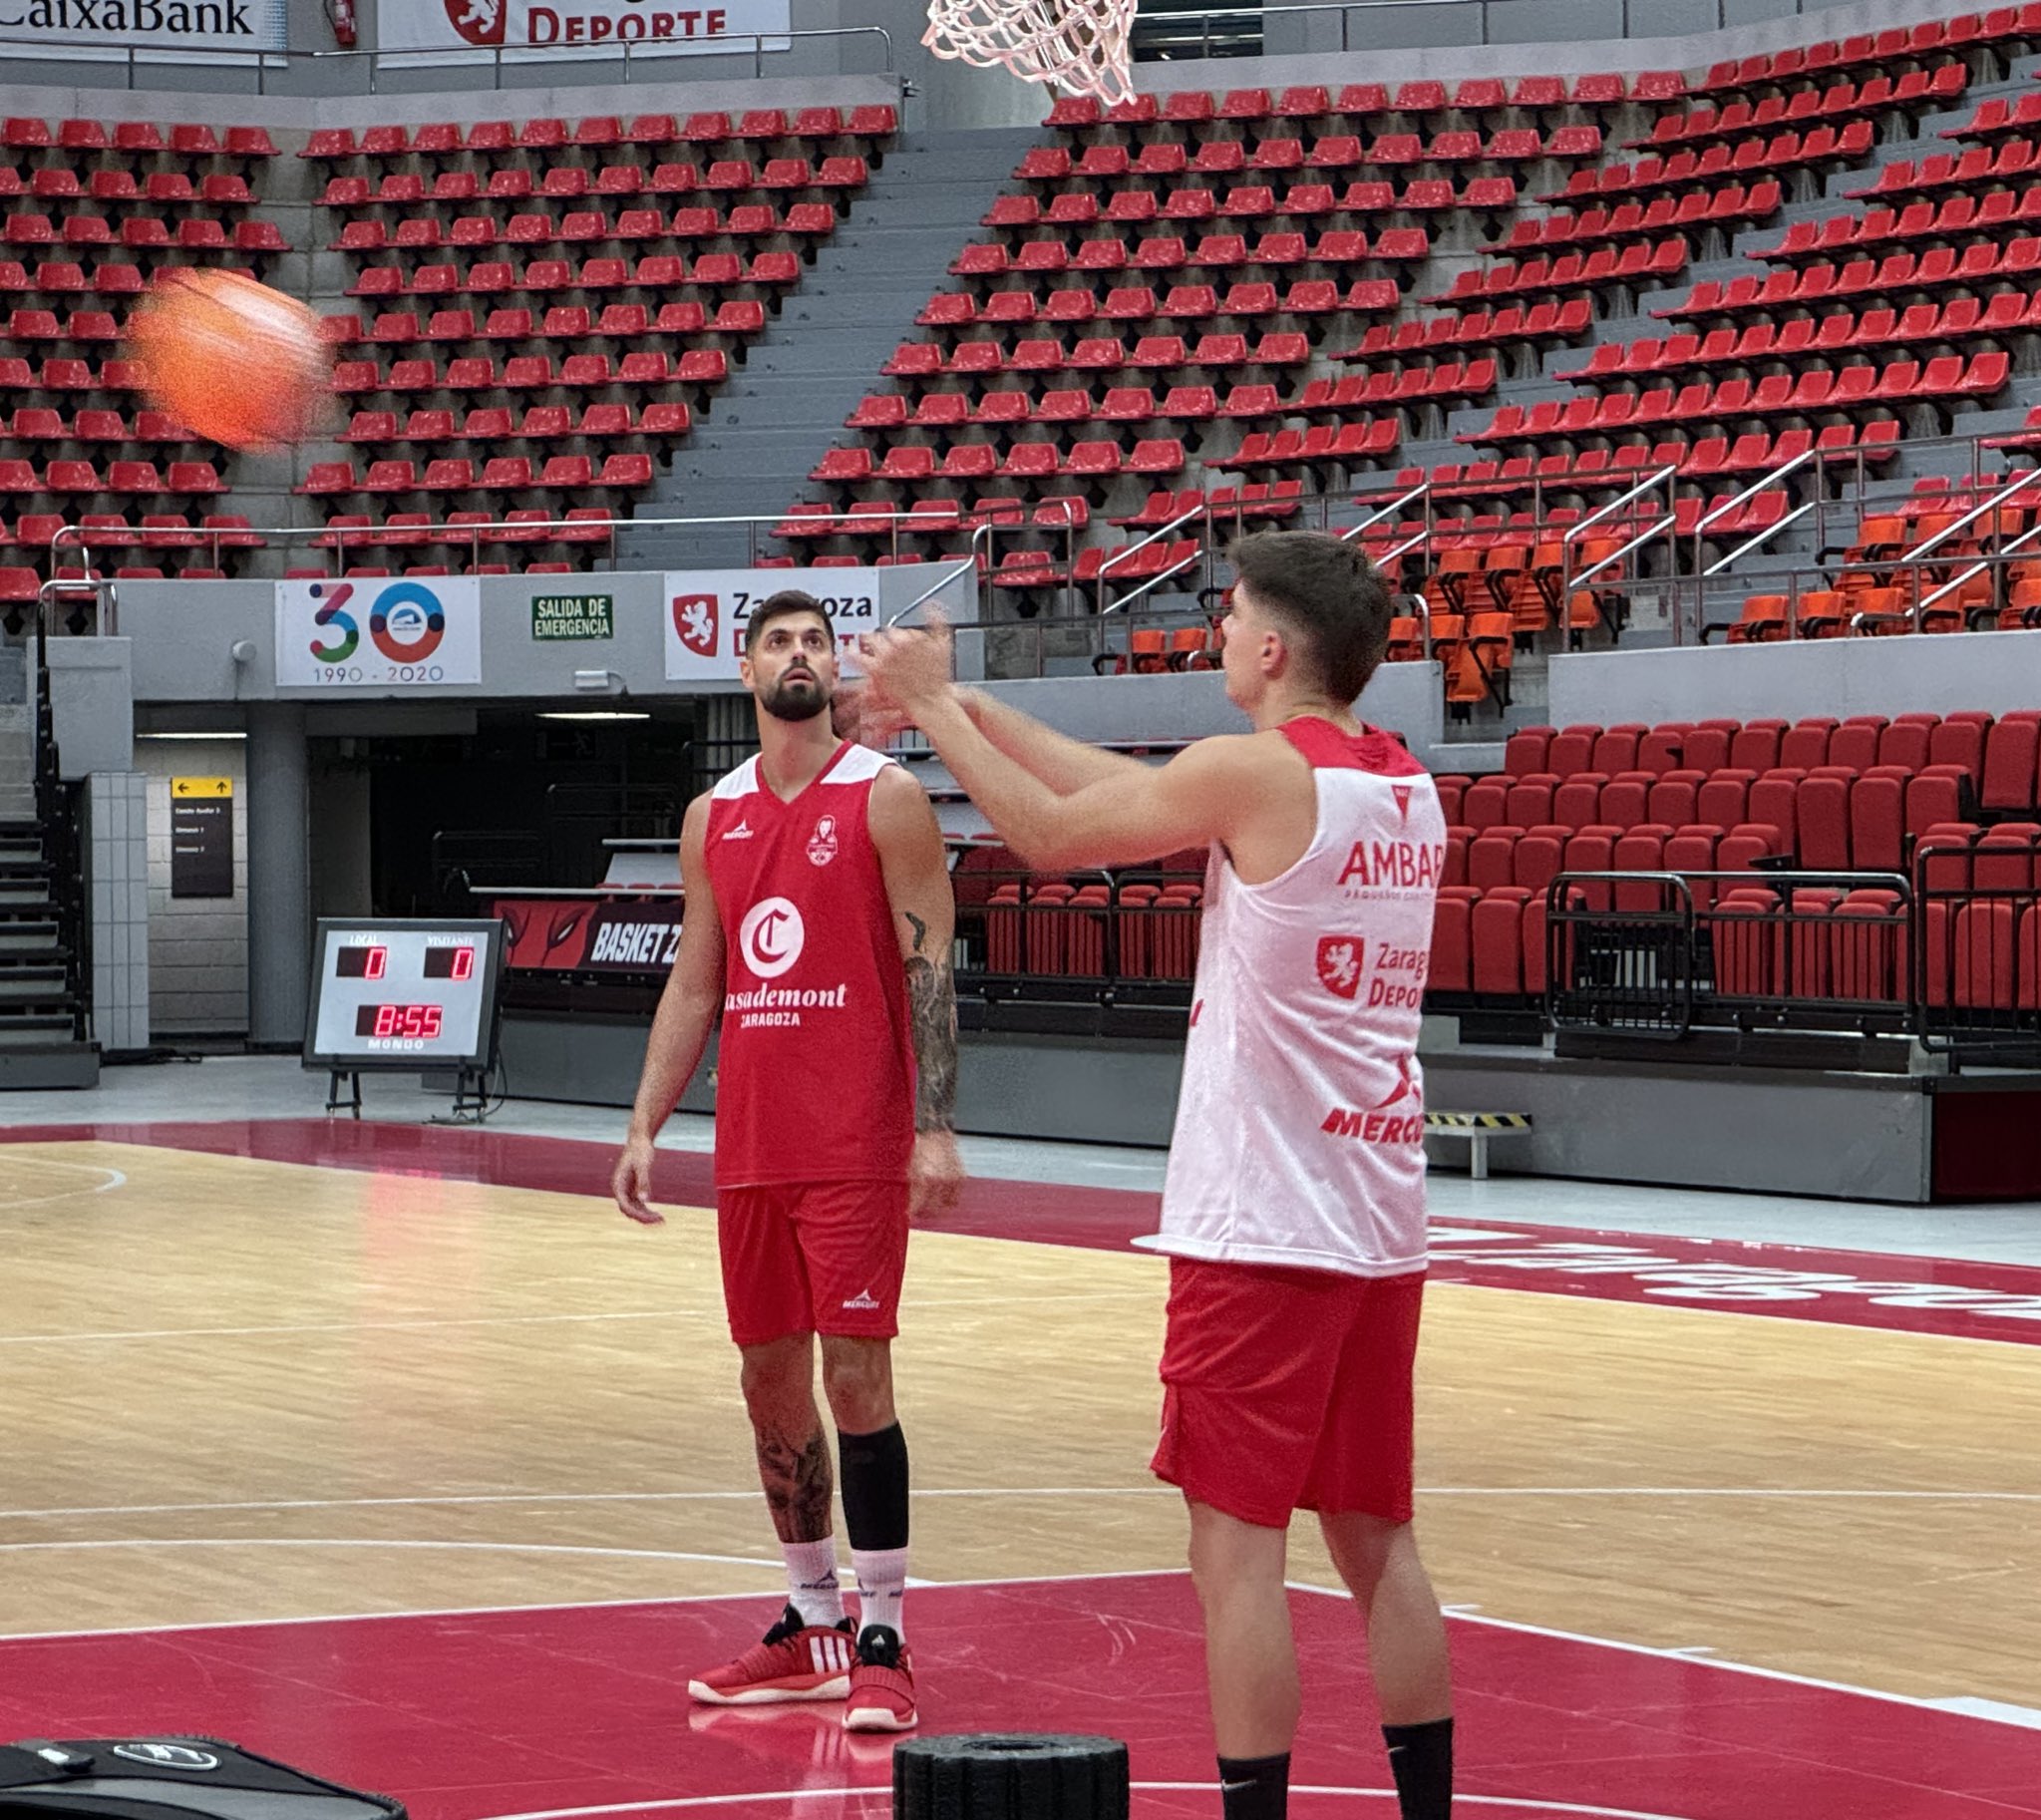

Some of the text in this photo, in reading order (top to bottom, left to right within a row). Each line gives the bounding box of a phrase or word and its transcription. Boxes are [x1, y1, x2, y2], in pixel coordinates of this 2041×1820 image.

[0, 0, 254, 35] aixaBank
[527, 9, 726, 48] DEPORTE
[538, 598, 606, 618] SALIDA DE
[534, 618, 609, 636] EMERGENCIA
[314, 667, 363, 683] 1990
[387, 665, 444, 682] 2020
[590, 922, 669, 963] BASKET
[365, 948, 474, 979] 0 0
[725, 982, 847, 1011] asademont
[1368, 977, 1423, 1008] DEPO
[375, 1005, 443, 1038] 8:55
[368, 1039, 424, 1050] MONDO
